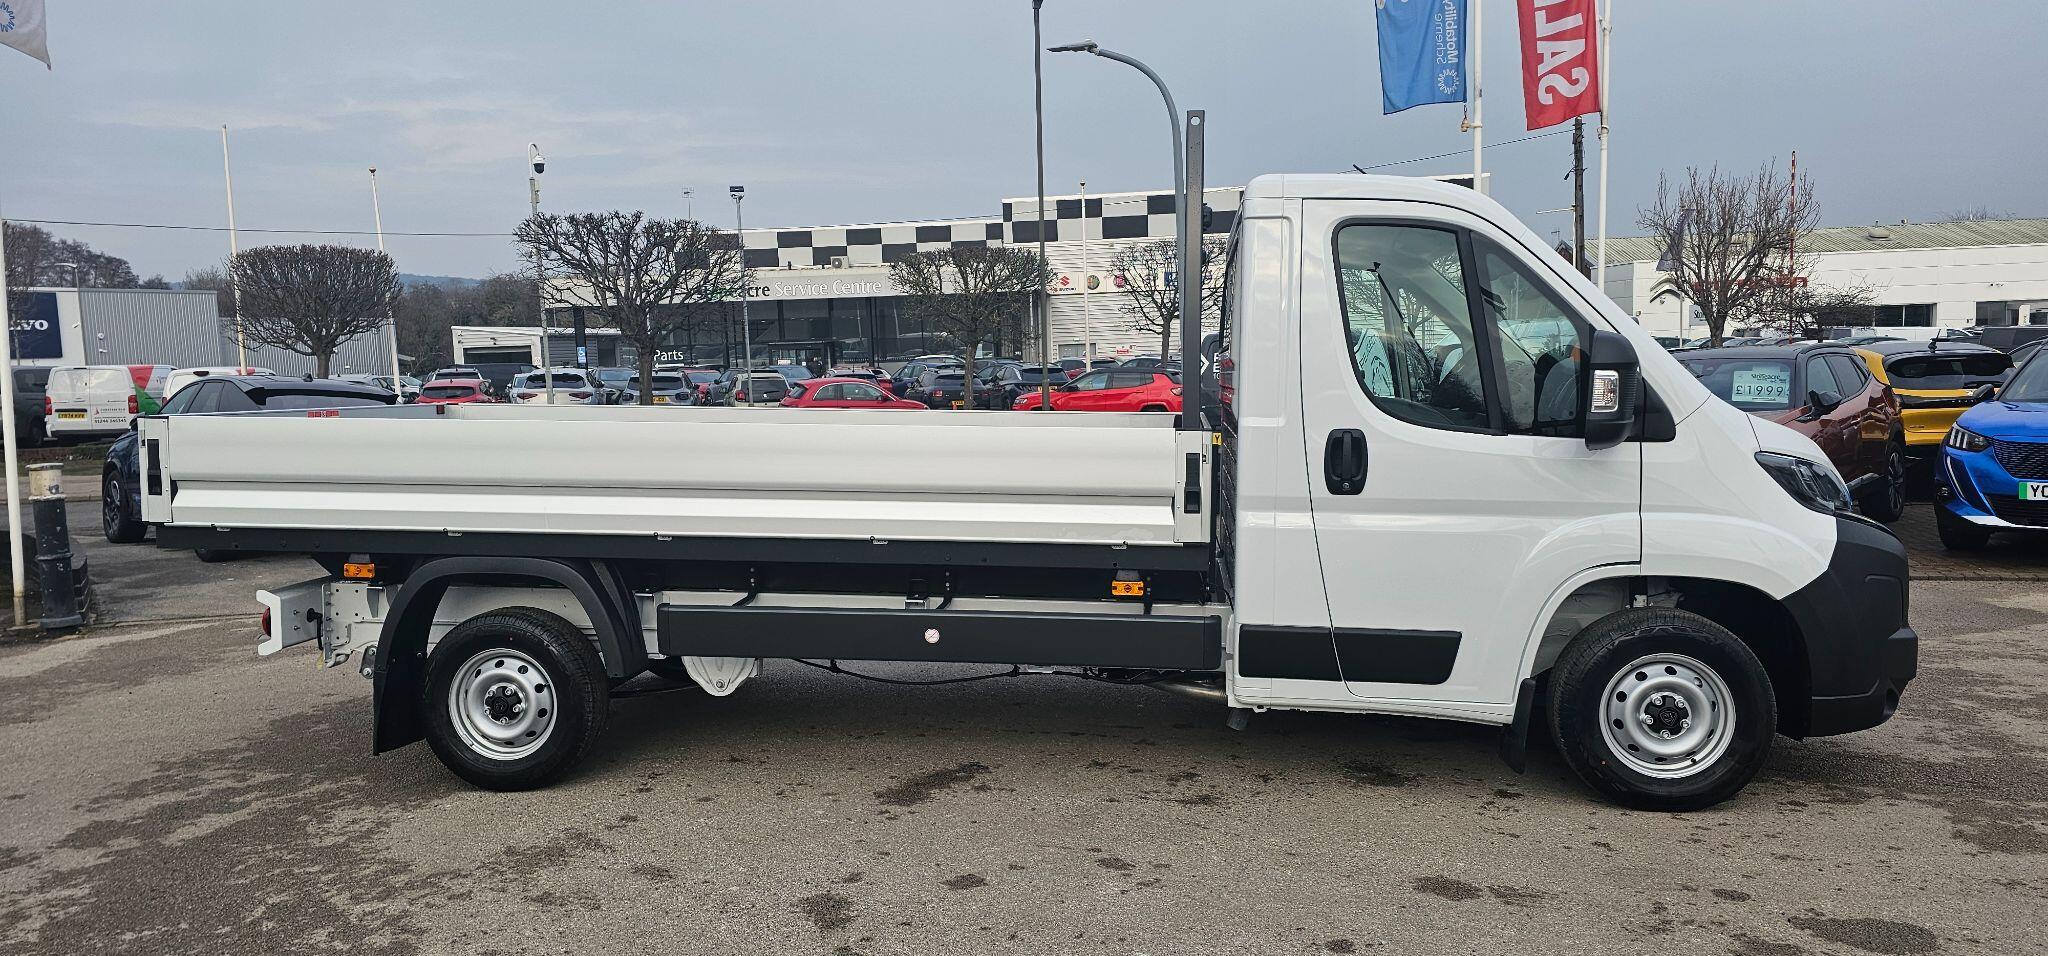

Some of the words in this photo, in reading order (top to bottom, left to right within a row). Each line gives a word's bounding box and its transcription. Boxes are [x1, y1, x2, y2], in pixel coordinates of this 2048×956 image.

[774, 280, 828, 297] Service
[832, 279, 882, 295] Centre
[653, 350, 684, 361] Parts
[1736, 385, 1788, 397] £1999
